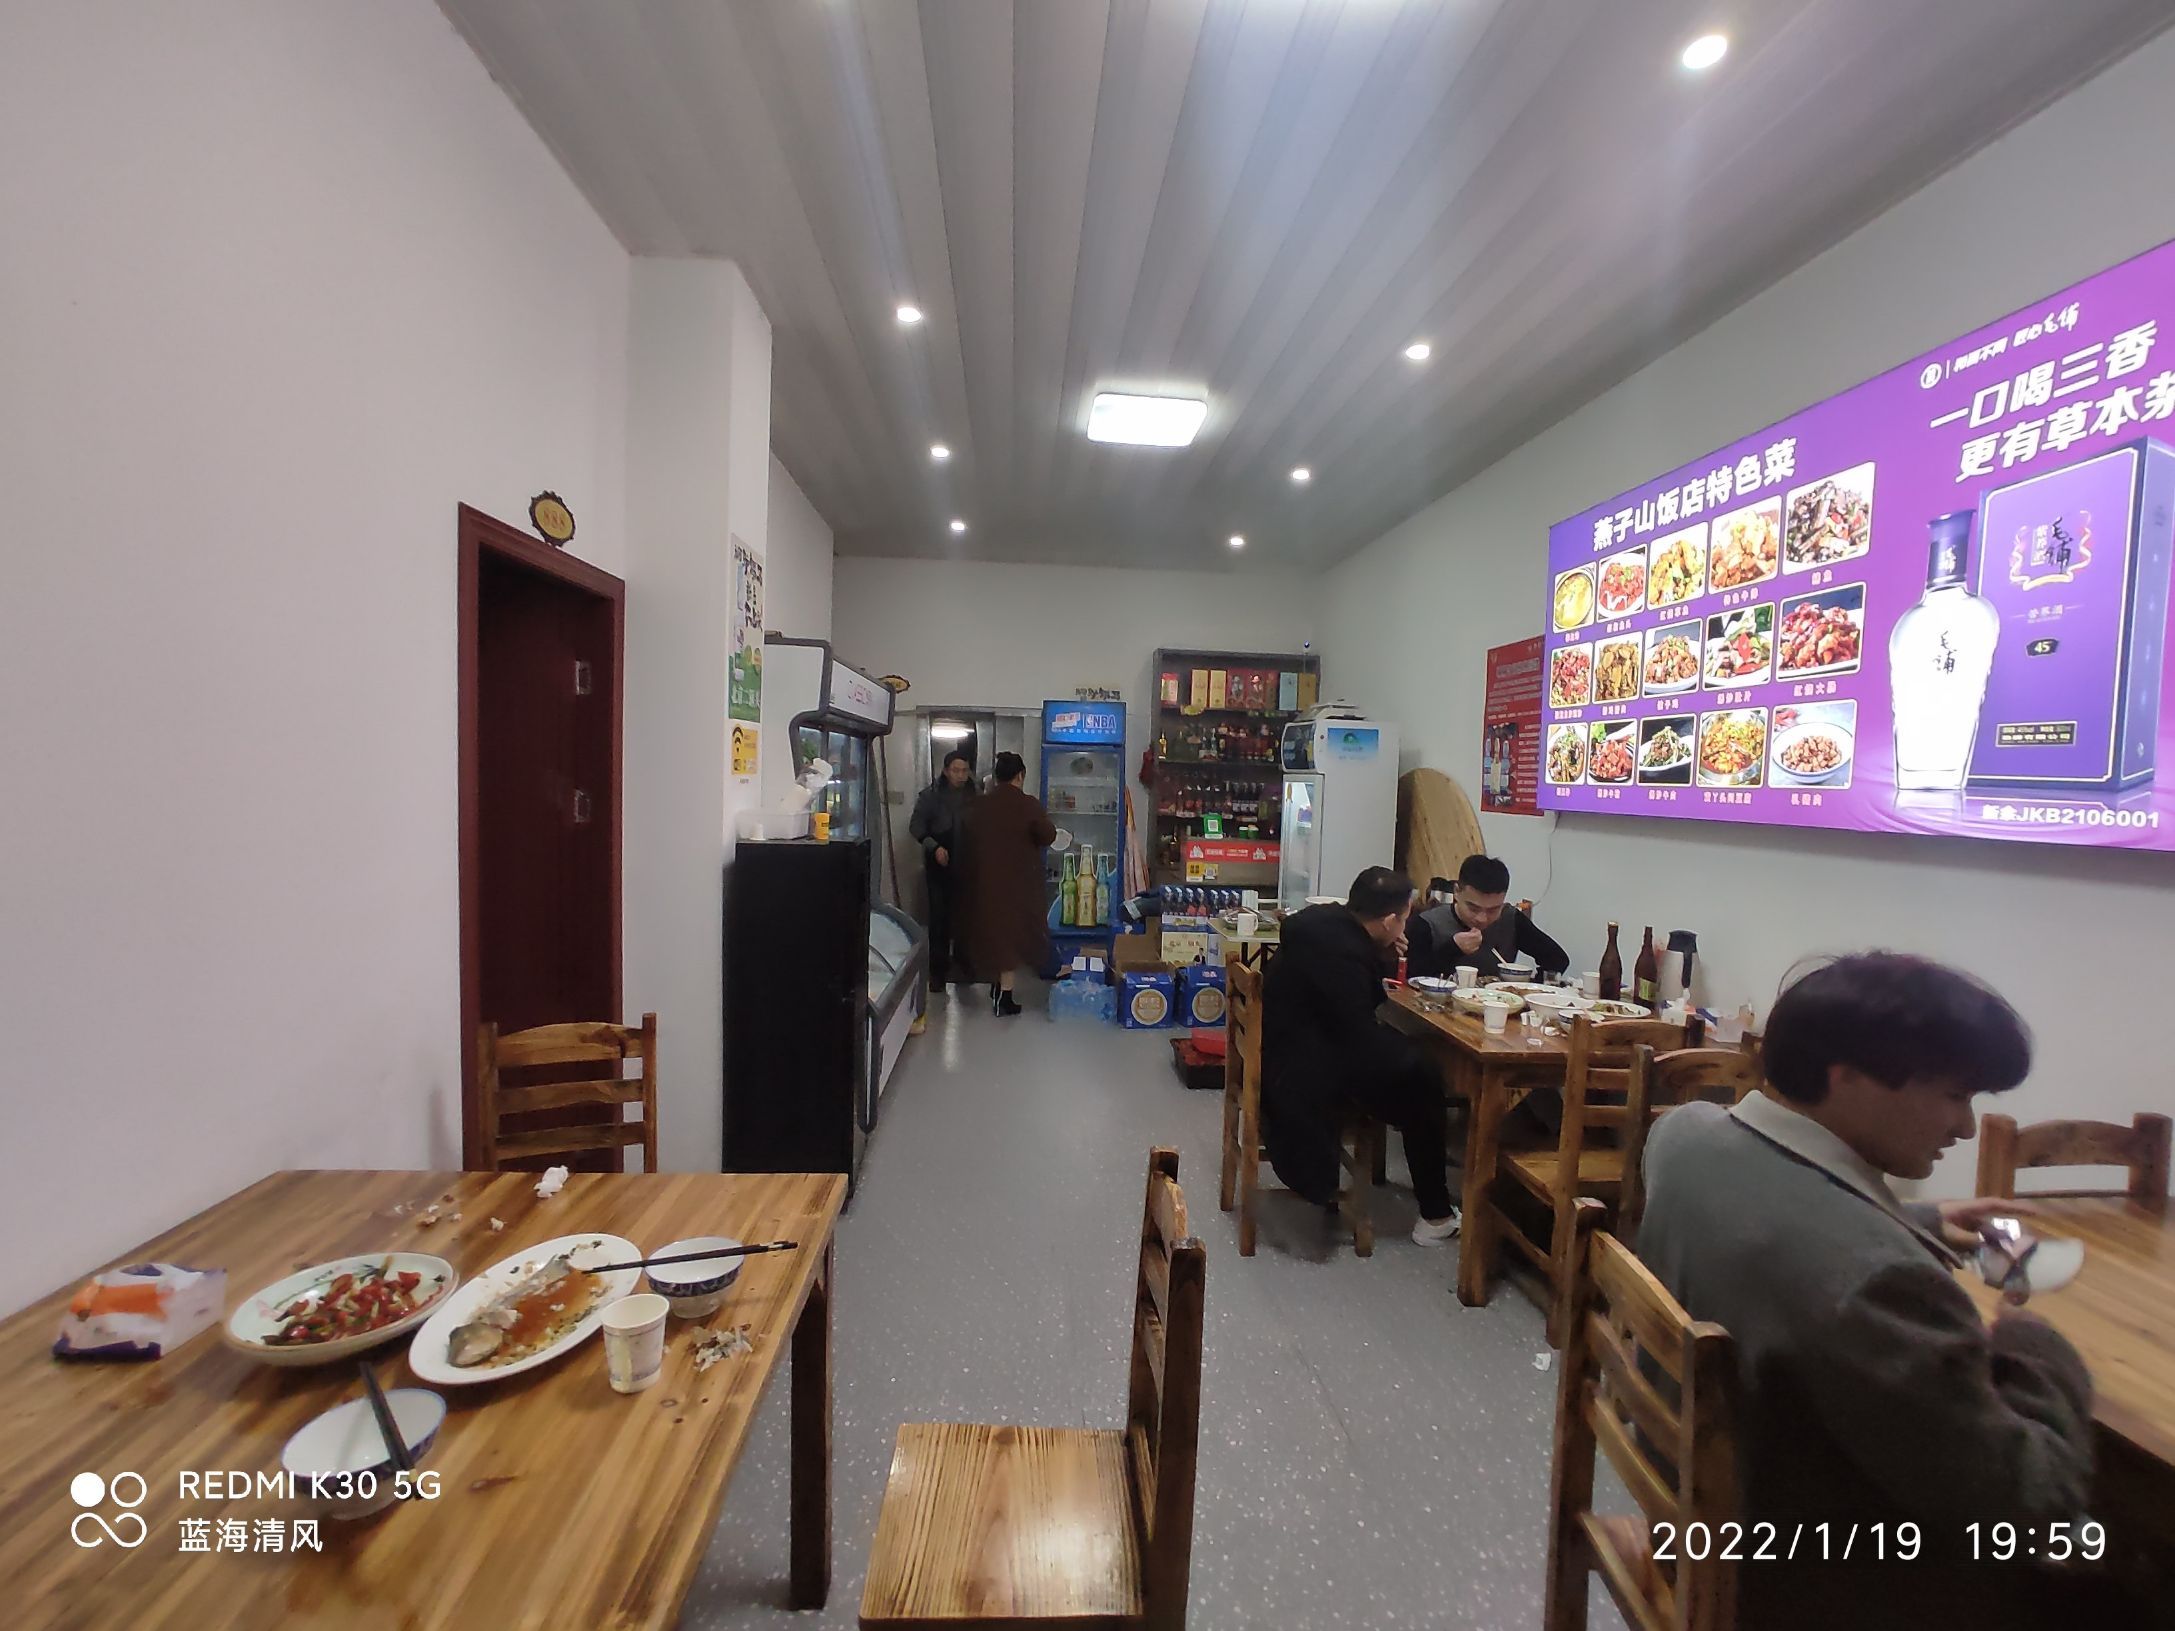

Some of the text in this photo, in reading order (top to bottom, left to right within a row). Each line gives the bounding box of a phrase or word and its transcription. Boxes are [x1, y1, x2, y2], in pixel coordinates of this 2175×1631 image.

[1929, 319, 2157, 429] 一口喝三香
[1593, 437, 1797, 552] 燕子山饭店特色菜
[2034, 641, 2051, 652] 45
[1094, 714, 1116, 728] NBA
